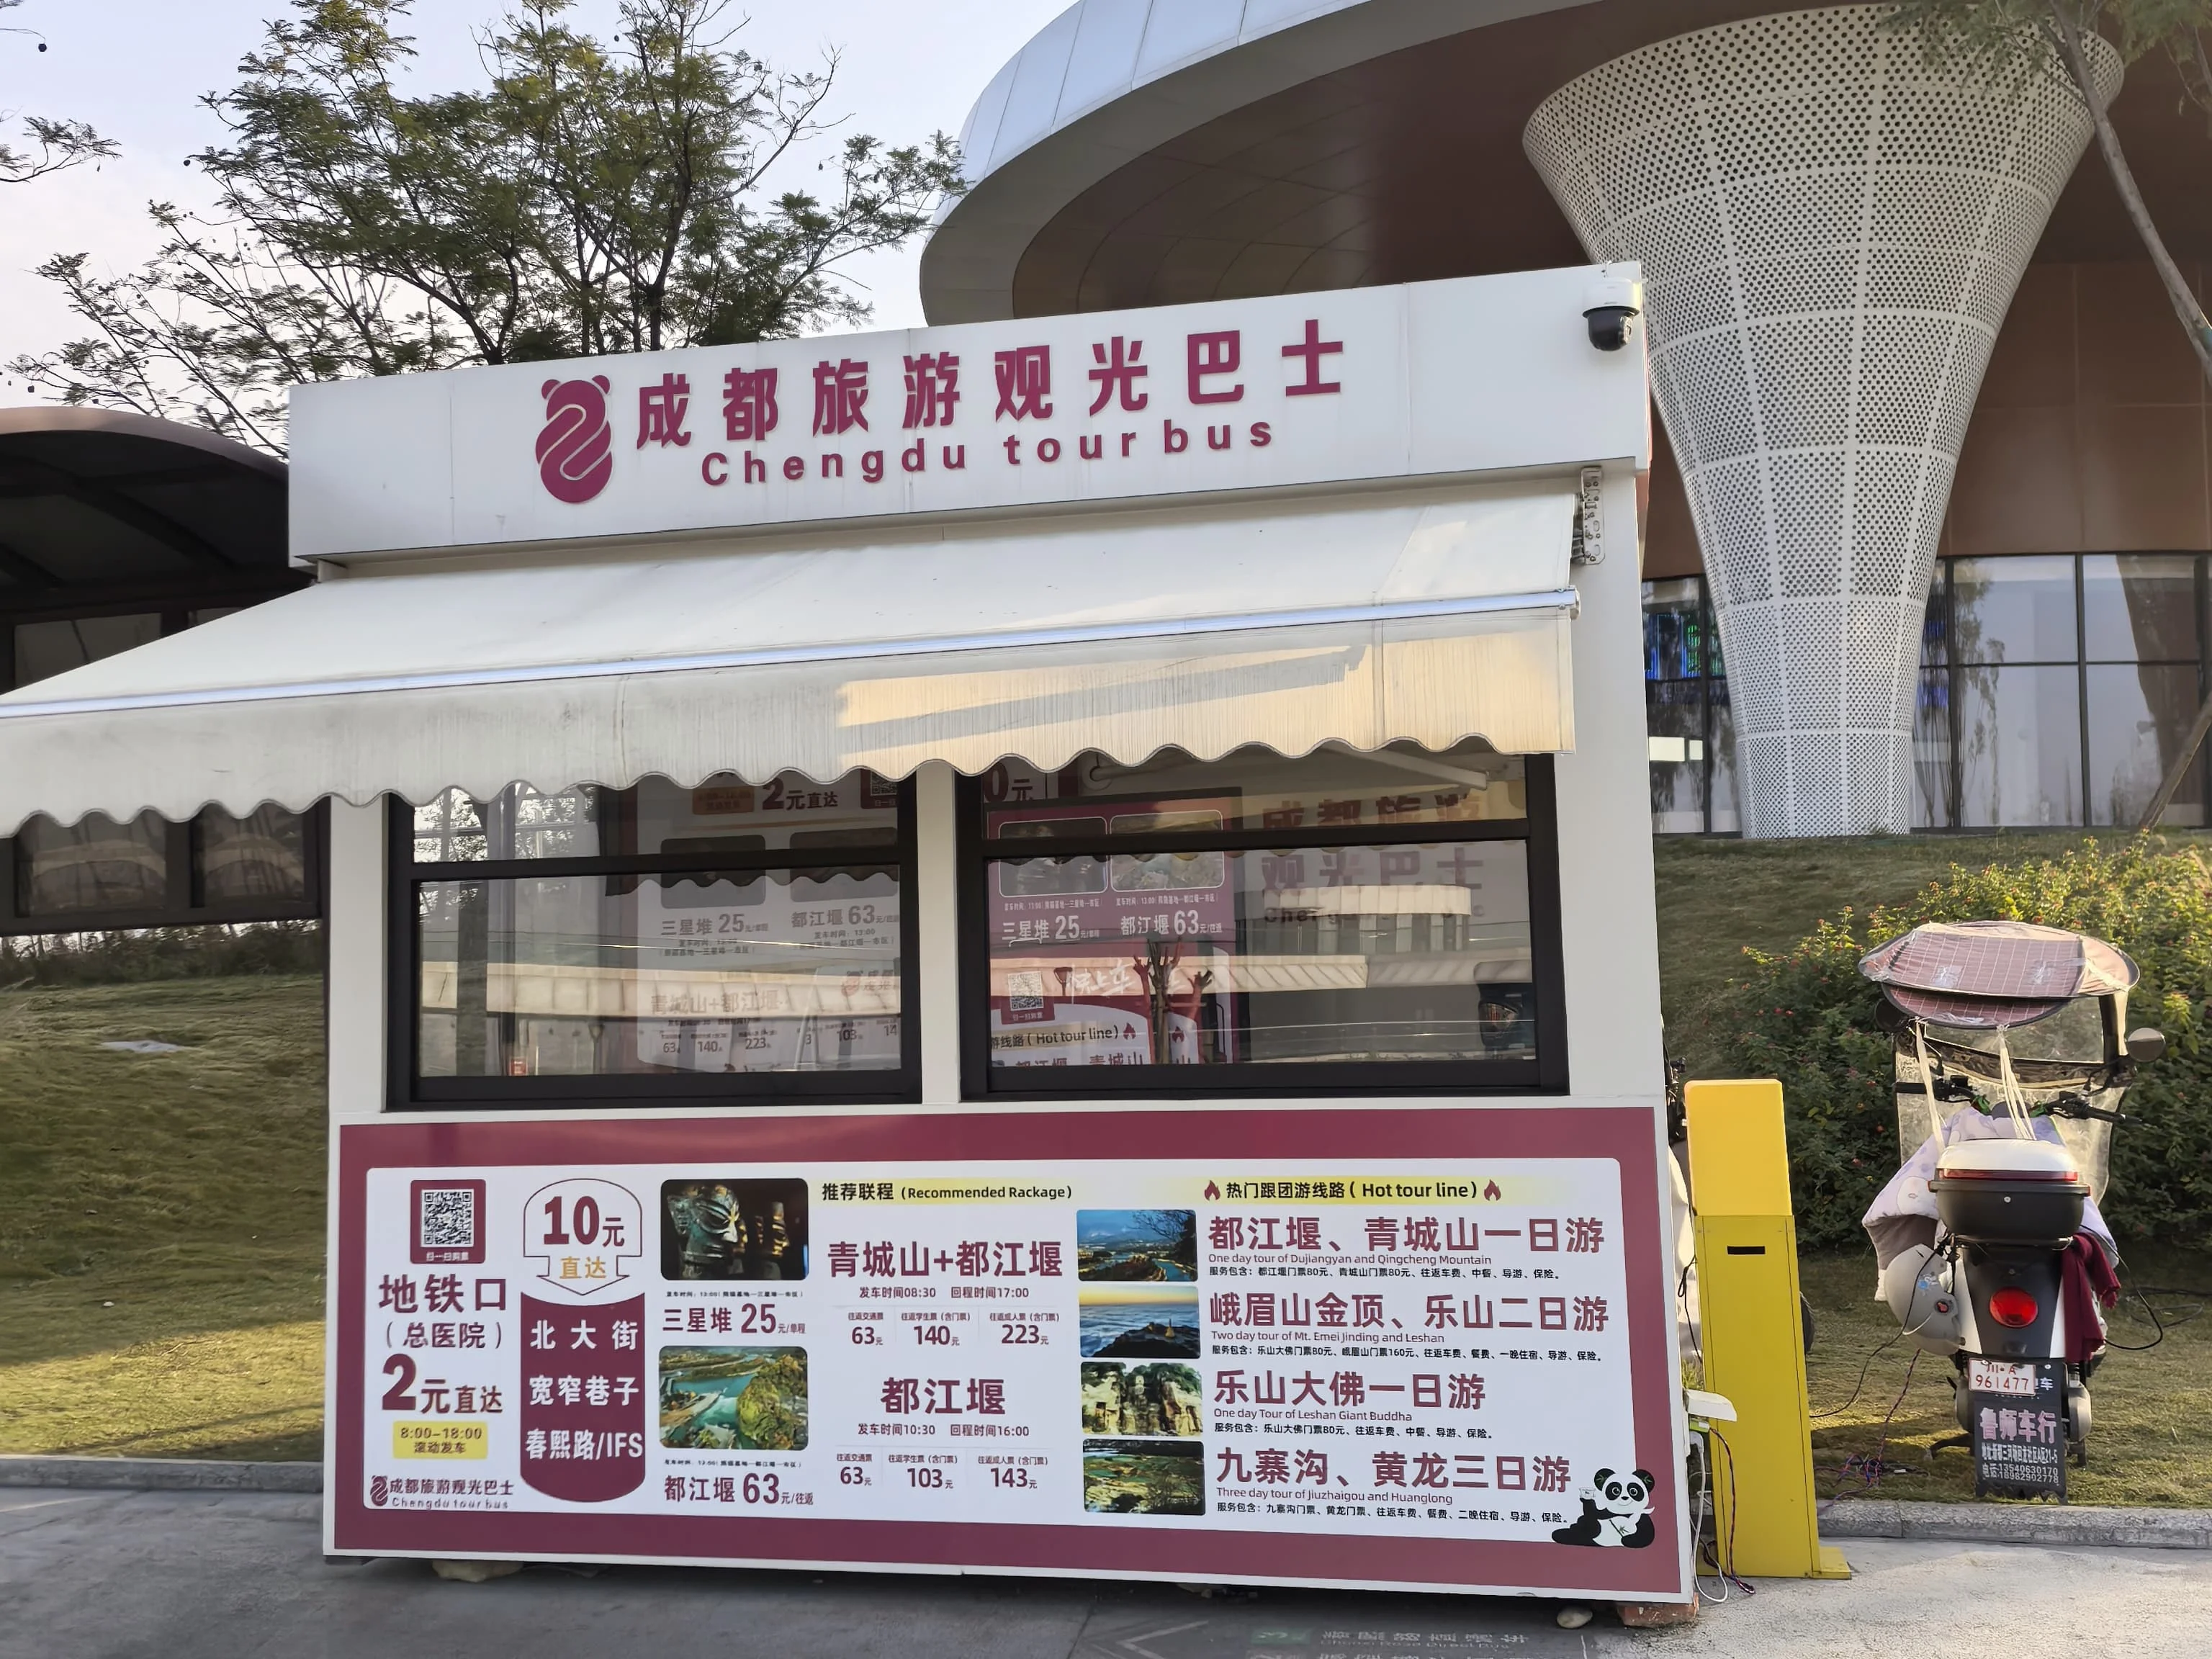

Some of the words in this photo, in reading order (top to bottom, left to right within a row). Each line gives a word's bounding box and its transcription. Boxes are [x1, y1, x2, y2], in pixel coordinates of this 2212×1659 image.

[637, 319, 1344, 450] 成都旅游观光巴士
[701, 437, 966, 486] Chengdu
[1002, 432, 1137, 465] tour
[1163, 419, 1273, 454] bus
[762, 777, 838, 811] 2元直达
[661, 918, 713, 936] 三星堆
[1002, 920, 1050, 940] 三星堆
[1060, 1029, 1089, 1043] tour
[822, 1183, 894, 1201] 推荐联程
[1362, 1182, 1395, 1198] Hot
[1397, 1184, 1432, 1198] tour
[544, 1196, 625, 1248] 10元
[1208, 1216, 1605, 1253] 都江堰、青城山一日游
[559, 1256, 606, 1279] 直达
[828, 1241, 1063, 1277] 青城山+都江堰
[1209, 1254, 1230, 1263] One
[1232, 1254, 1252, 1265] day
[1278, 1254, 1289, 1263] of
[1290, 1254, 1353, 1266] Dujiangyan
[1355, 1254, 1375, 1264] and
[1377, 1255, 1436, 1266] Qingcheng
[1439, 1256, 1491, 1265] Mountain
[378, 1274, 506, 1313] 地铁口
[860, 1287, 936, 1298] 发车时间08:30
[950, 1287, 1030, 1298] 回程时间17:00
[662, 1307, 732, 1334] 三星堆
[1210, 1292, 1609, 1332] 峨眉山金顶、乐山二日游
[530, 1319, 639, 1350] 北大街
[851, 1326, 884, 1346] 63元
[913, 1326, 960, 1346] 140元
[1001, 1324, 1049, 1345] 223元
[1211, 1331, 1233, 1341] Two
[1236, 1331, 1255, 1343] day
[1257, 1332, 1279, 1341] tour
[1282, 1331, 1292, 1341] of
[1295, 1332, 1311, 1341] Mt.
[1314, 1332, 1339, 1341] Emei
[1382, 1333, 1403, 1342] and
[1406, 1334, 1444, 1343] Leshan
[382, 1353, 503, 1413] 2元直达
[529, 1375, 639, 1406] 宽窄巷子
[1214, 1370, 1485, 1410] 乐山大佛一日游
[1976, 1375, 2029, 1391] 961477
[881, 1377, 1006, 1415] 都江堰
[1214, 1408, 1236, 1417] One
[1238, 1408, 1257, 1420] day
[1259, 1409, 1282, 1419] Tour
[1285, 1409, 1296, 1419] of
[1298, 1410, 1336, 1420] Leshan
[1339, 1411, 1367, 1421] Giant
[1370, 1411, 1412, 1421] Buddha
[858, 1423, 936, 1436] 发车时间10:30
[950, 1424, 1030, 1437] 回程时间16:00
[526, 1428, 644, 1460] 春熙路/IFS
[840, 1466, 872, 1486] 63元
[907, 1467, 954, 1489] 103元
[990, 1467, 1038, 1489] 143元
[1217, 1447, 1571, 1493] 九寨沟、黄龙三日游
[390, 1478, 515, 1496] 成都旅游观光巴士
[665, 1475, 735, 1503] 都江堰
[1216, 1487, 1246, 1497] Three
[1249, 1488, 1269, 1500] day
[1271, 1489, 1293, 1498] tour
[1295, 1488, 1306, 1498] of
[1307, 1490, 1364, 1502] Jiuzhaigou
[1367, 1491, 1388, 1501] and
[1392, 1492, 1452, 1505] Huanglong
[392, 1497, 449, 1510] Chengdu
[454, 1498, 482, 1509] tour
[485, 1498, 508, 1509] bus
